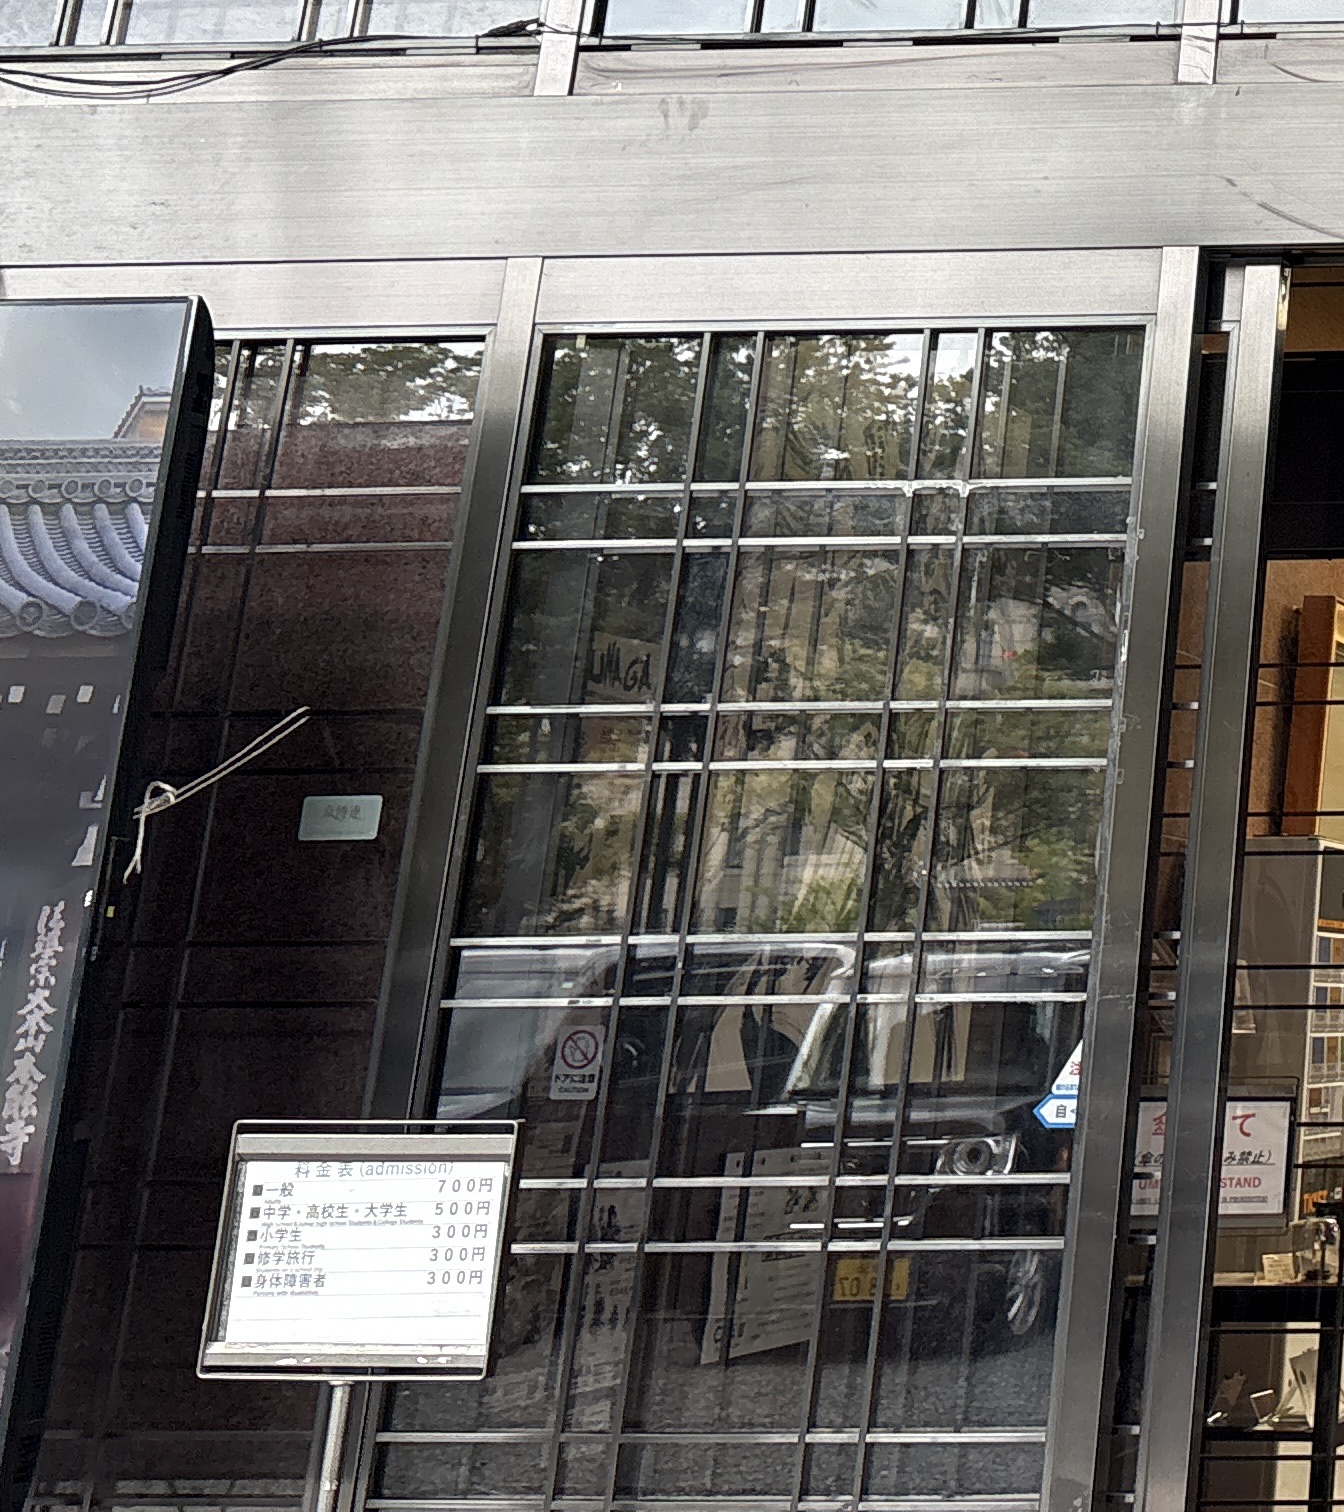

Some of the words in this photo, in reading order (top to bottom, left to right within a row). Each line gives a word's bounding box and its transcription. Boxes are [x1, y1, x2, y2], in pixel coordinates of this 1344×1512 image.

[294, 1162, 354, 1179] 料金表
[359, 1162, 454, 1177] (admission)
[265, 1181, 295, 1198] 一般
[437, 1178, 494, 1193] 700円
[1219, 1176, 1262, 1189] STAND
[434, 1201, 491, 1216] 500円
[259, 1226, 303, 1243] 小学生
[431, 1224, 488, 1239] 300円
[257, 1250, 316, 1266] 修学旅行
[429, 1247, 486, 1262] 300円
[426, 1269, 483, 1285] 300円
